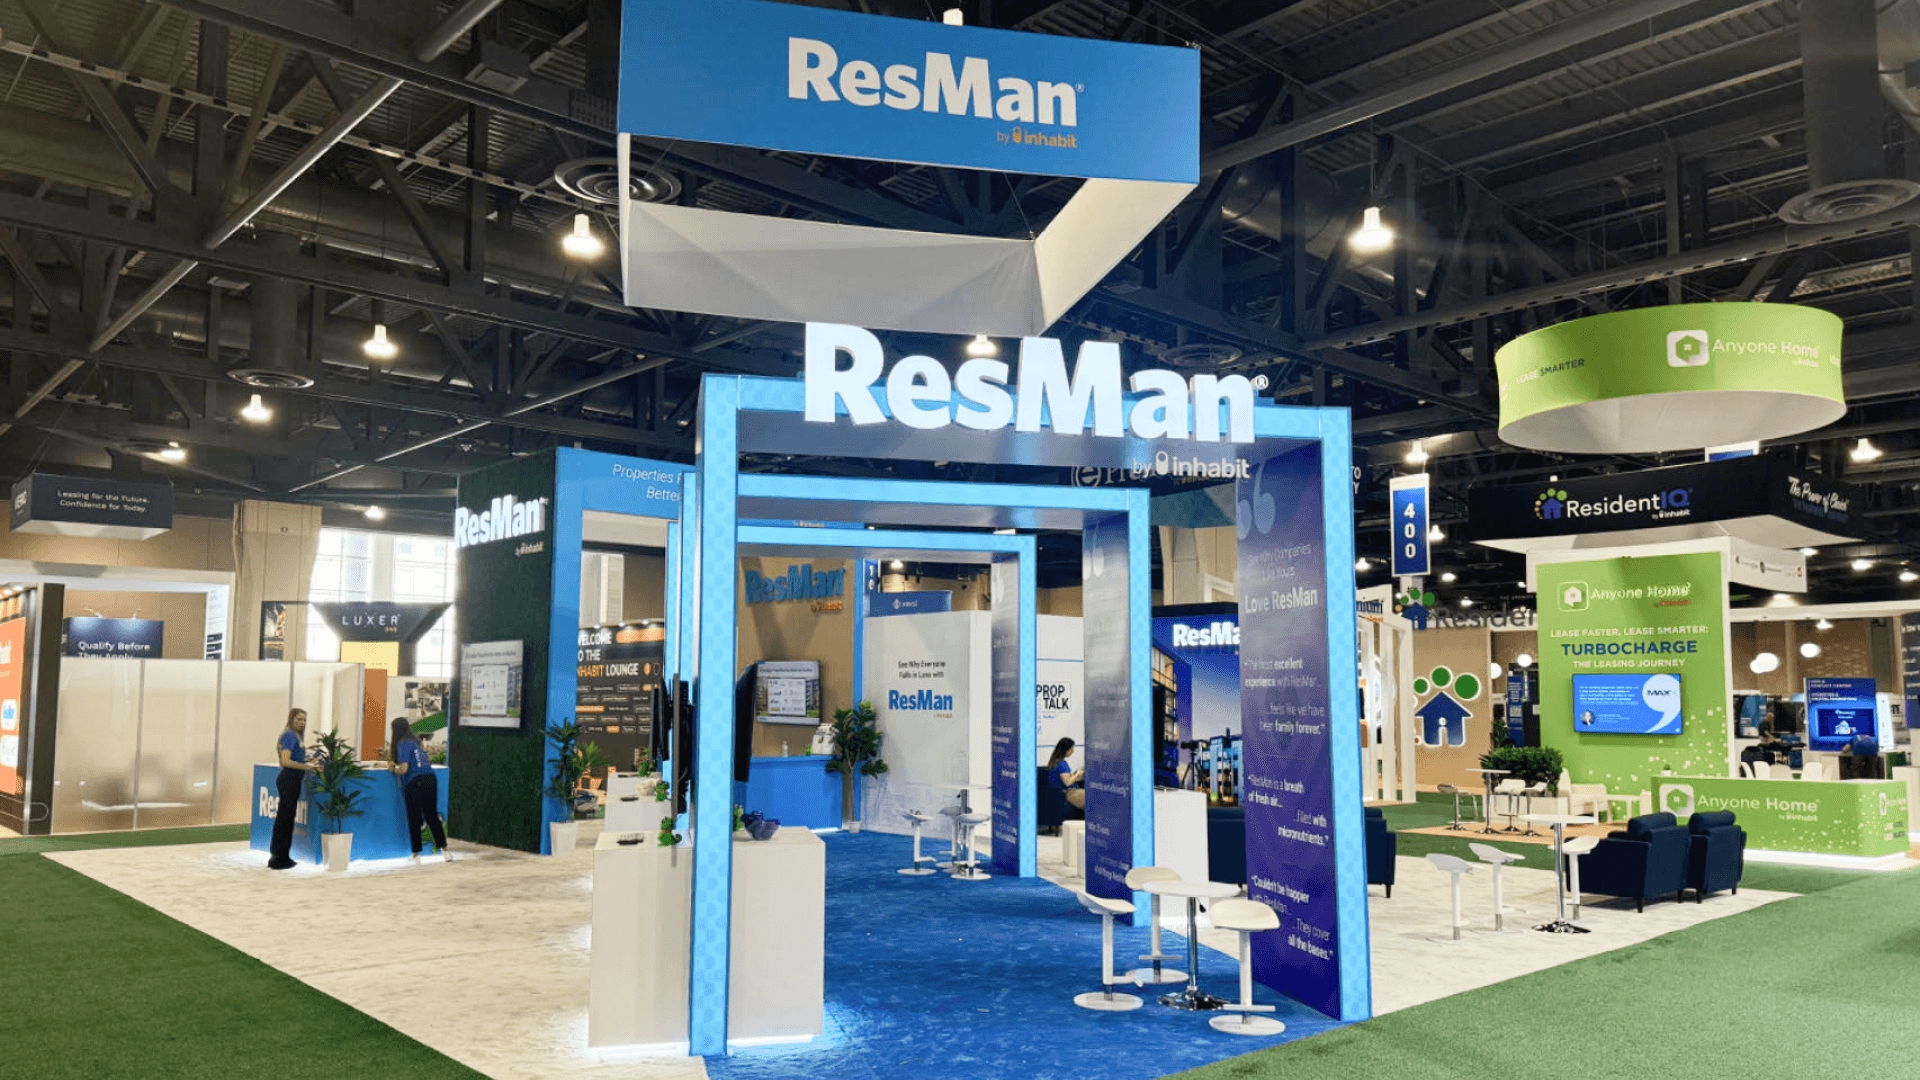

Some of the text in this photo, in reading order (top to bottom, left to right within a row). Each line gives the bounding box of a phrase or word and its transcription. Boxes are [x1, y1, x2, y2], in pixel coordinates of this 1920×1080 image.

[996, 129, 1079, 149] by inhabit
[1712, 339, 1819, 358] Anyone Home
[1540, 358, 1585, 377] SMARTER
[612, 463, 674, 485] Properties
[1133, 456, 1251, 479] by inhabit
[91, 491, 104, 500] for
[105, 493, 119, 501] the
[108, 503, 121, 511] for
[1664, 508, 1691, 518] inhabit
[1403, 502, 1417, 559] 400
[1245, 586, 1319, 614] Love ResMan
[1590, 585, 1690, 601] Anyone Home
[342, 615, 400, 626] LUXER
[1173, 621, 1240, 647] ResMa
[1550, 625, 1709, 638] LEASE FASTER, LEASE SMARTER:
[78, 641, 151, 652] Qualify Before
[1561, 640, 1698, 656] TURBOCHARGE
[585, 648, 602, 662] THE
[606, 663, 640, 676] LOUNGE
[921, 660, 946, 670] Everyone
[1573, 658, 1685, 669] THE LEASING JOURNEY
[1036, 683, 1066, 698] PROP
[888, 689, 953, 710] ResMan
[1044, 697, 1070, 711] TALK
[1697, 794, 1818, 812] Anyone Home
